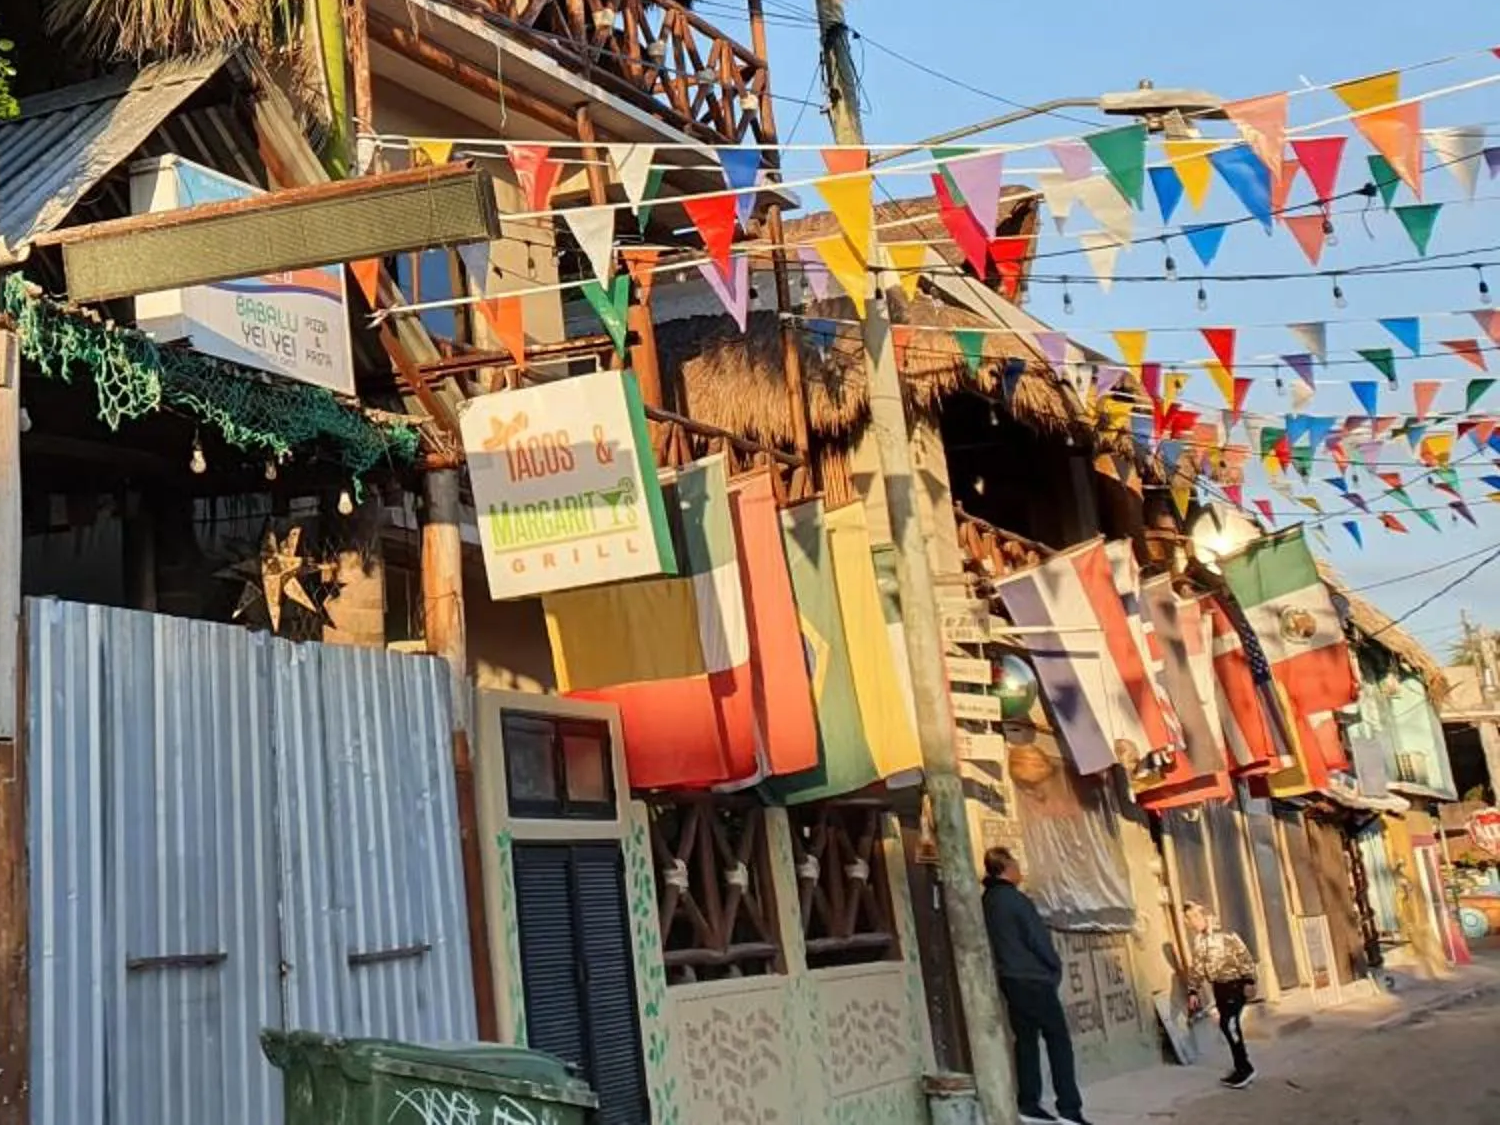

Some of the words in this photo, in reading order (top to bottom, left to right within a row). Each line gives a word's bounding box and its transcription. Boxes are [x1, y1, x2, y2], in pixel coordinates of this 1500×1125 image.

[236, 295, 298, 332] BABALU
[242, 321, 267, 348] YEI
[270, 331, 296, 357] YEI
[506, 429, 575, 482] TACOS
[592, 424, 615, 465] &
[511, 537, 640, 574] GRILL
